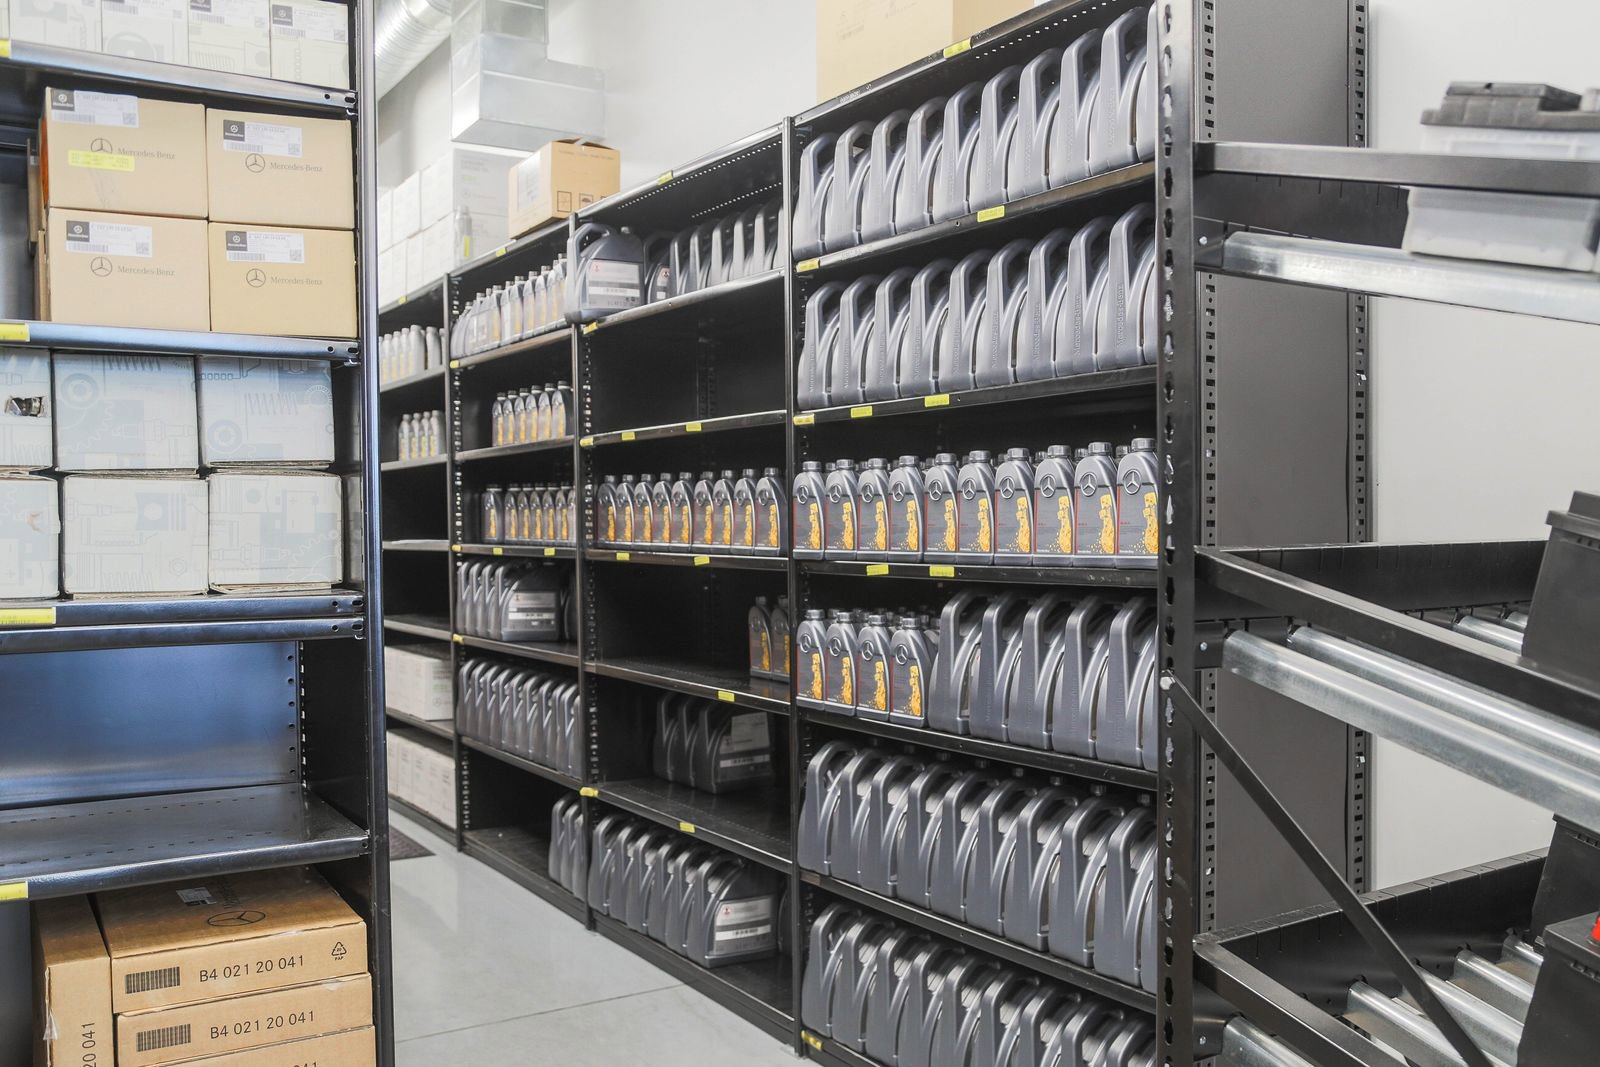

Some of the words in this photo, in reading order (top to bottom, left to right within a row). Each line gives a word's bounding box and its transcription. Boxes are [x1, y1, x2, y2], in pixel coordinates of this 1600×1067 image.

[117, 147, 176, 160] Mercedes-Benz
[270, 161, 323, 173] Mercedes-Benz
[117, 264, 176, 277] Mercedes-Benz
[270, 276, 323, 287] Mercedes-Benz
[199, 968, 218, 982] B4
[223, 963, 249, 978] 021
[256, 959, 274, 973] 20
[278, 955, 303, 970] 041
[210, 1025, 229, 1039] B4
[233, 1019, 260, 1035] 021
[266, 1015, 284, 1029] 20
[288, 1010, 314, 1025] 041
[81, 1022, 96, 1049] 041
